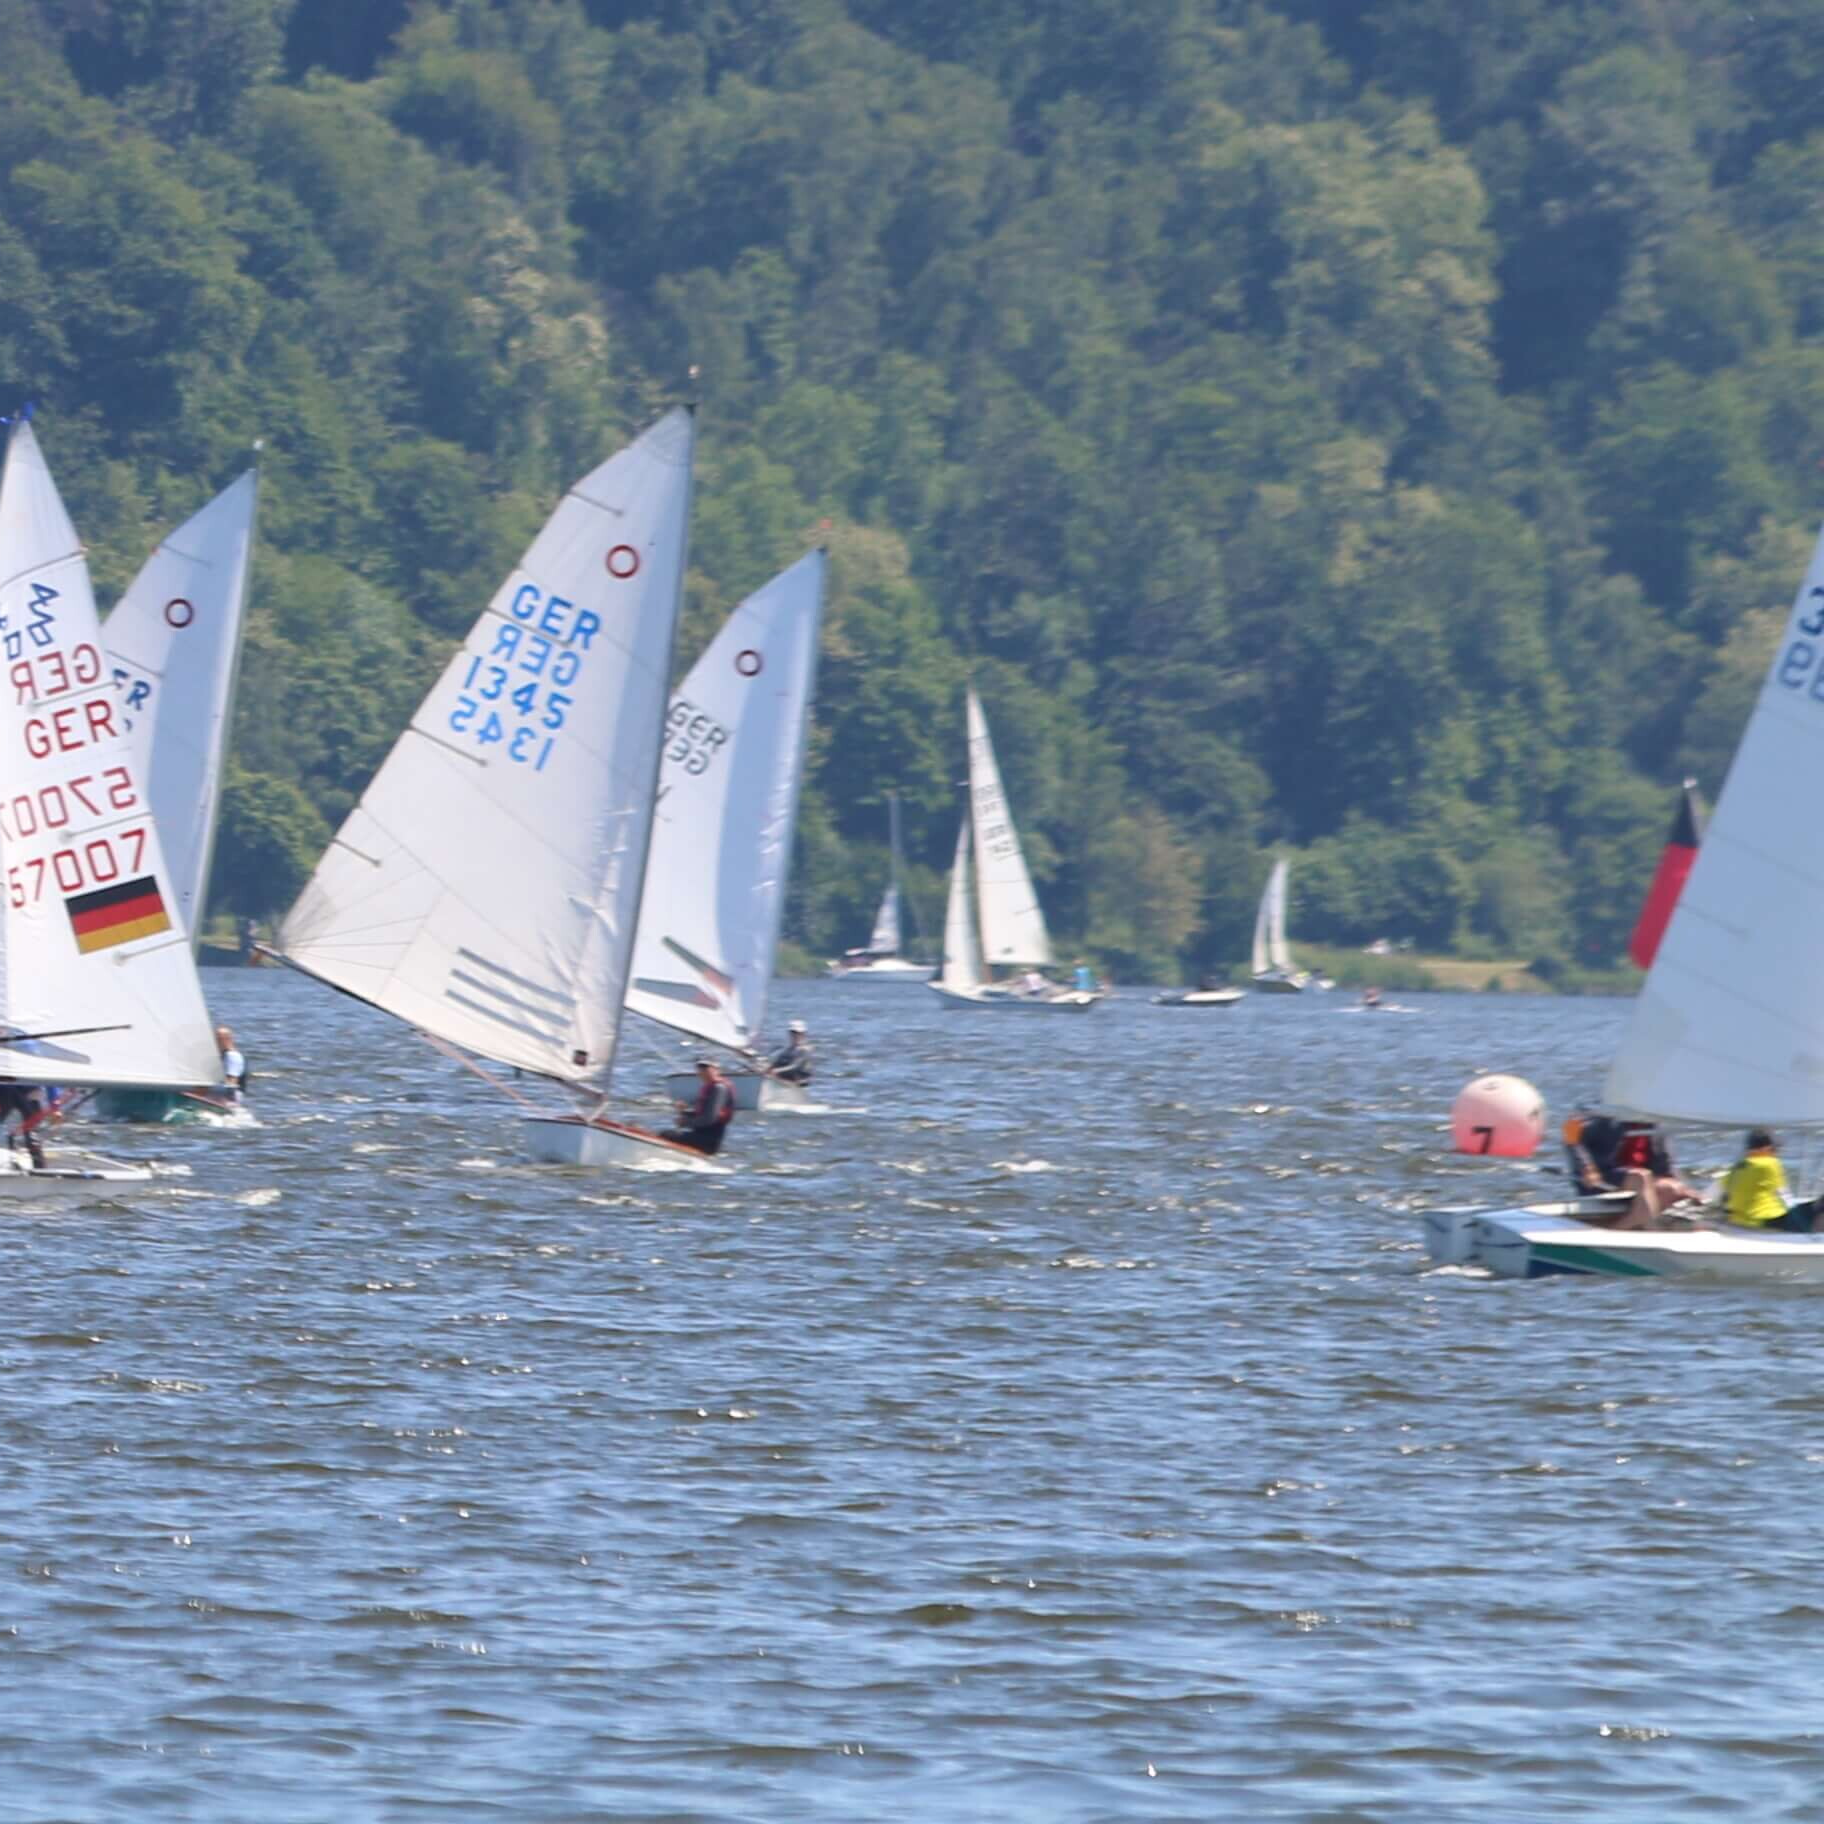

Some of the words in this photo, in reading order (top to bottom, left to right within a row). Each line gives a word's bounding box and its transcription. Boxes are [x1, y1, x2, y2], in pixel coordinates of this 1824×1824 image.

[511, 584, 601, 650] GER
[463, 656, 573, 729] 1345
[24, 700, 119, 759] GER
[670, 701, 727, 754] GER
[8, 828, 145, 908] 57007
[1471, 1126, 1494, 1154] 7
